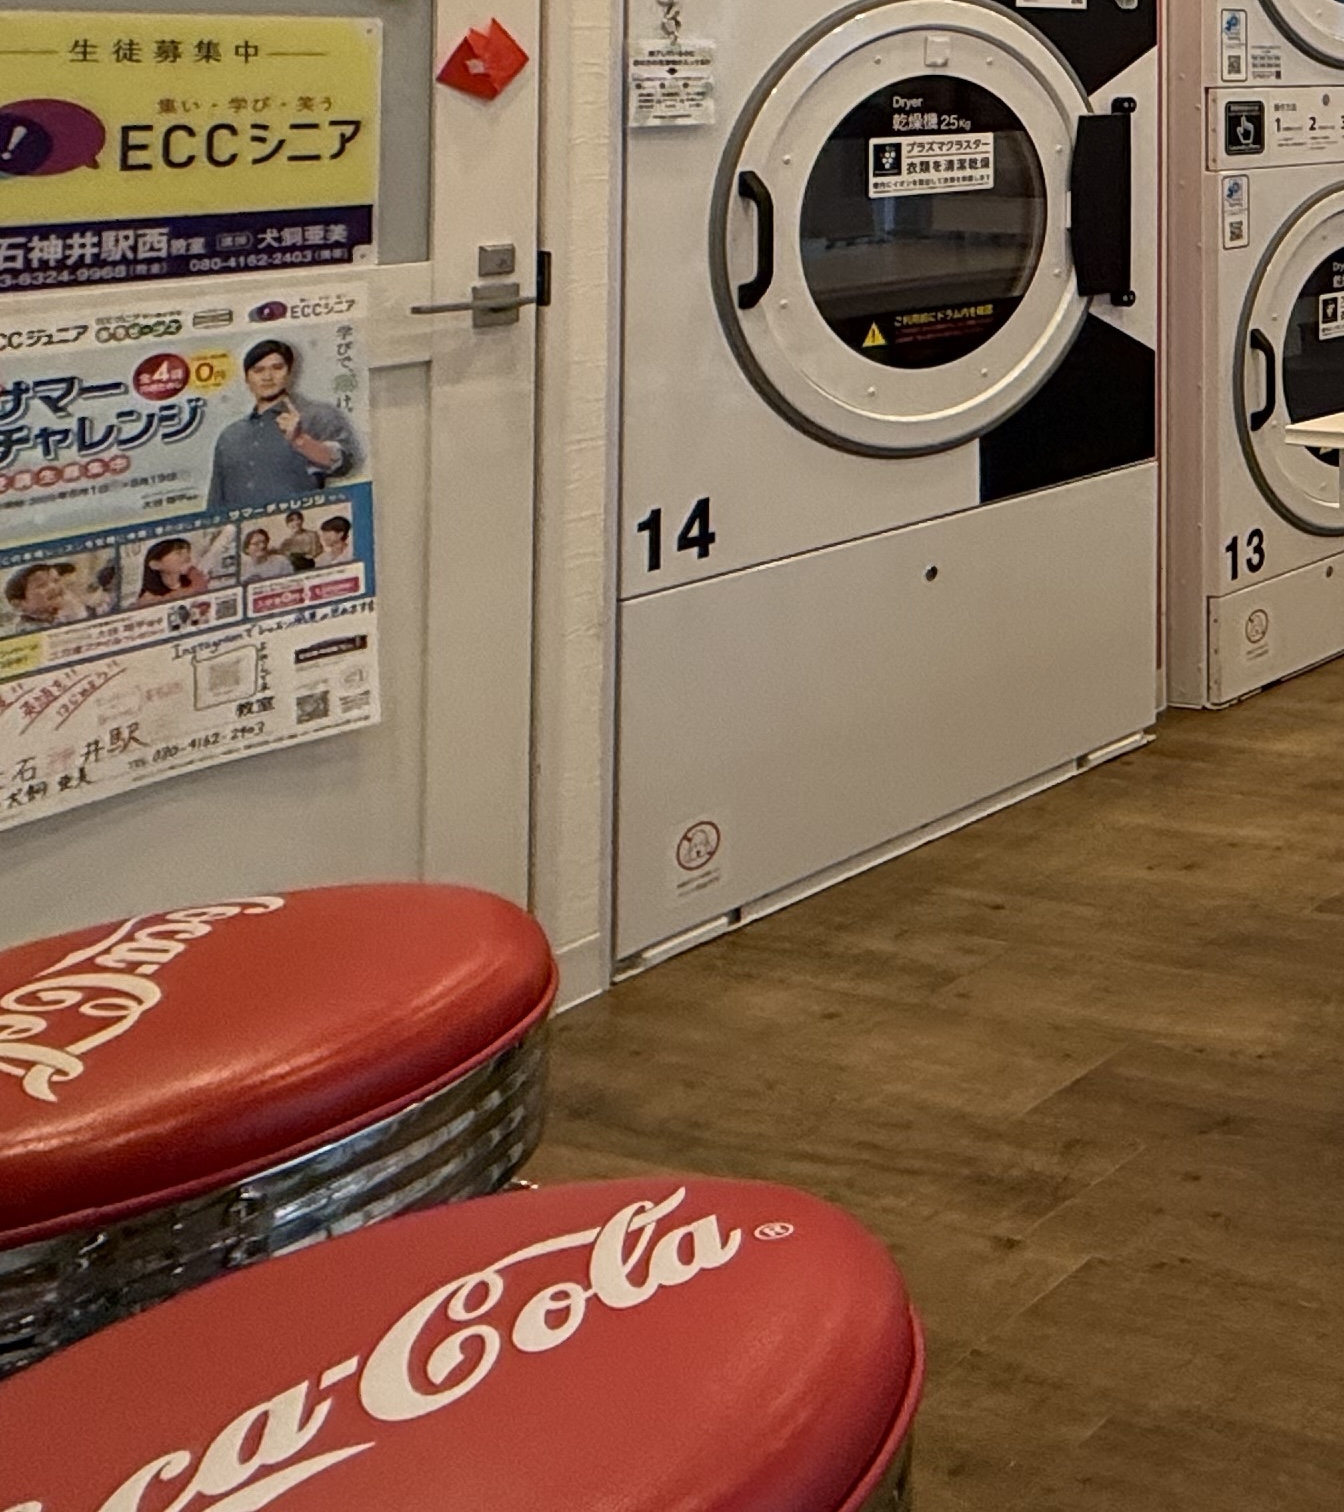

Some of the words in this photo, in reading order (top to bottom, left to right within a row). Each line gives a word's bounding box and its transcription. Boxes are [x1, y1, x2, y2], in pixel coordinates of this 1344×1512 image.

[68, 39, 261, 65] 生徒募集中
[157, 96, 334, 115] 集い・学び・笑う
[892, 96, 923, 111] Dryer
[892, 112, 939, 131] 乾燥機
[118, 119, 362, 172] ECCシニア
[906, 139, 991, 154] プラズマクラスター
[906, 157, 990, 175] 衣類を清潔乾燥
[290, 298, 355, 319] ECCシニア
[636, 496, 716, 572] 14
[1224, 527, 1266, 581] 13
[0, 1186, 742, 1512] ca-Cola
